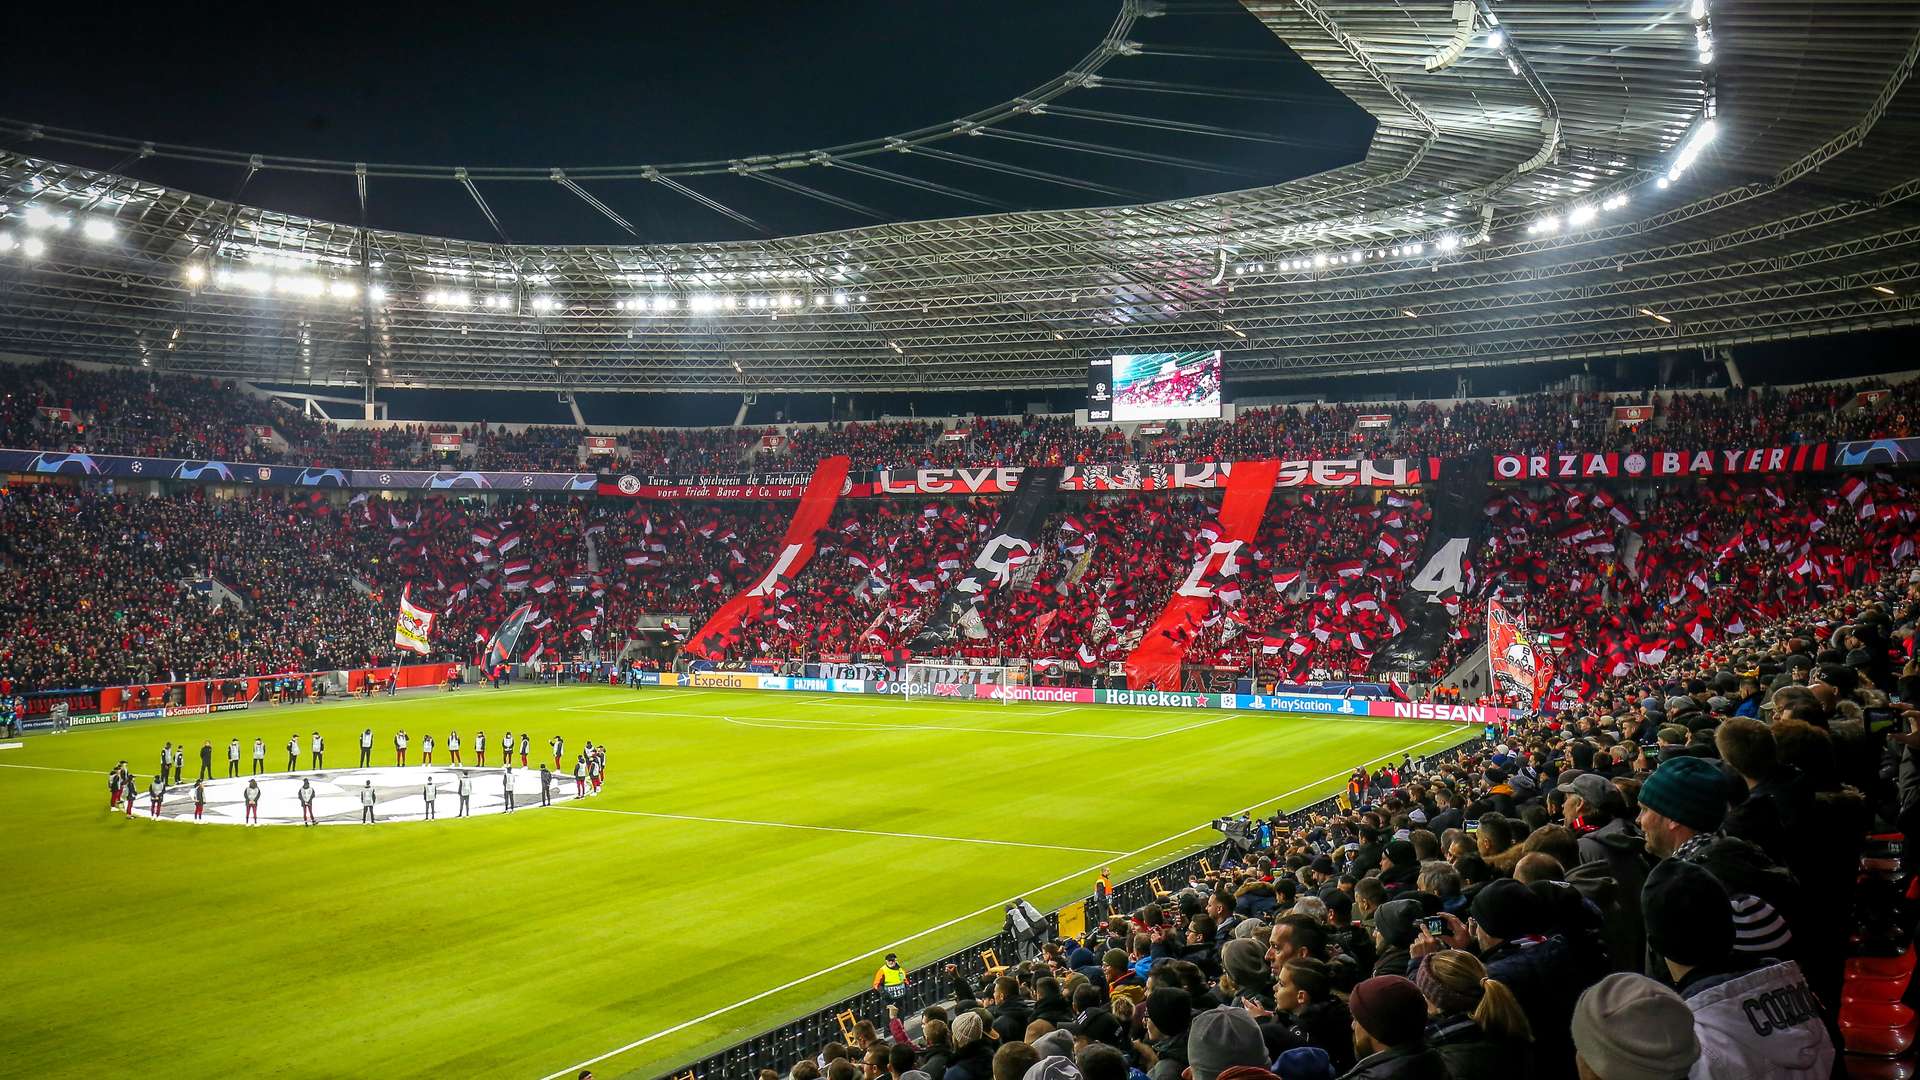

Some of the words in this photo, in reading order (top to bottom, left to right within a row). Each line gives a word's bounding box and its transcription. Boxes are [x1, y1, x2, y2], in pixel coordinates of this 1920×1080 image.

[1662, 448, 1784, 473] BAYER
[648, 475, 672, 486] Turn-
[679, 475, 693, 486] und
[699, 475, 740, 488] Spielverein
[747, 474, 759, 485] der
[765, 473, 812, 488] Farbenfabri
[685, 487, 711, 497] Friedr.
[717, 487, 739, 498] Bayer
[759, 486, 771, 497] Co.
[778, 489, 791, 497] von
[694, 674, 742, 688] Expedia
[794, 679, 827, 691] GAZPROM
[890, 681, 931, 697] pepsi
[933, 683, 962, 697] MAX
[1005, 686, 1078, 702] Santander
[1105, 689, 1192, 708] Heineken
[1271, 697, 1331, 712] PlayStation
[173, 705, 207, 716] Santander
[217, 702, 248, 712] mastercard
[1394, 703, 1485, 722] NISSAN
[73, 715, 111, 725] Heineken
[128, 711, 156, 720] PlayStation
